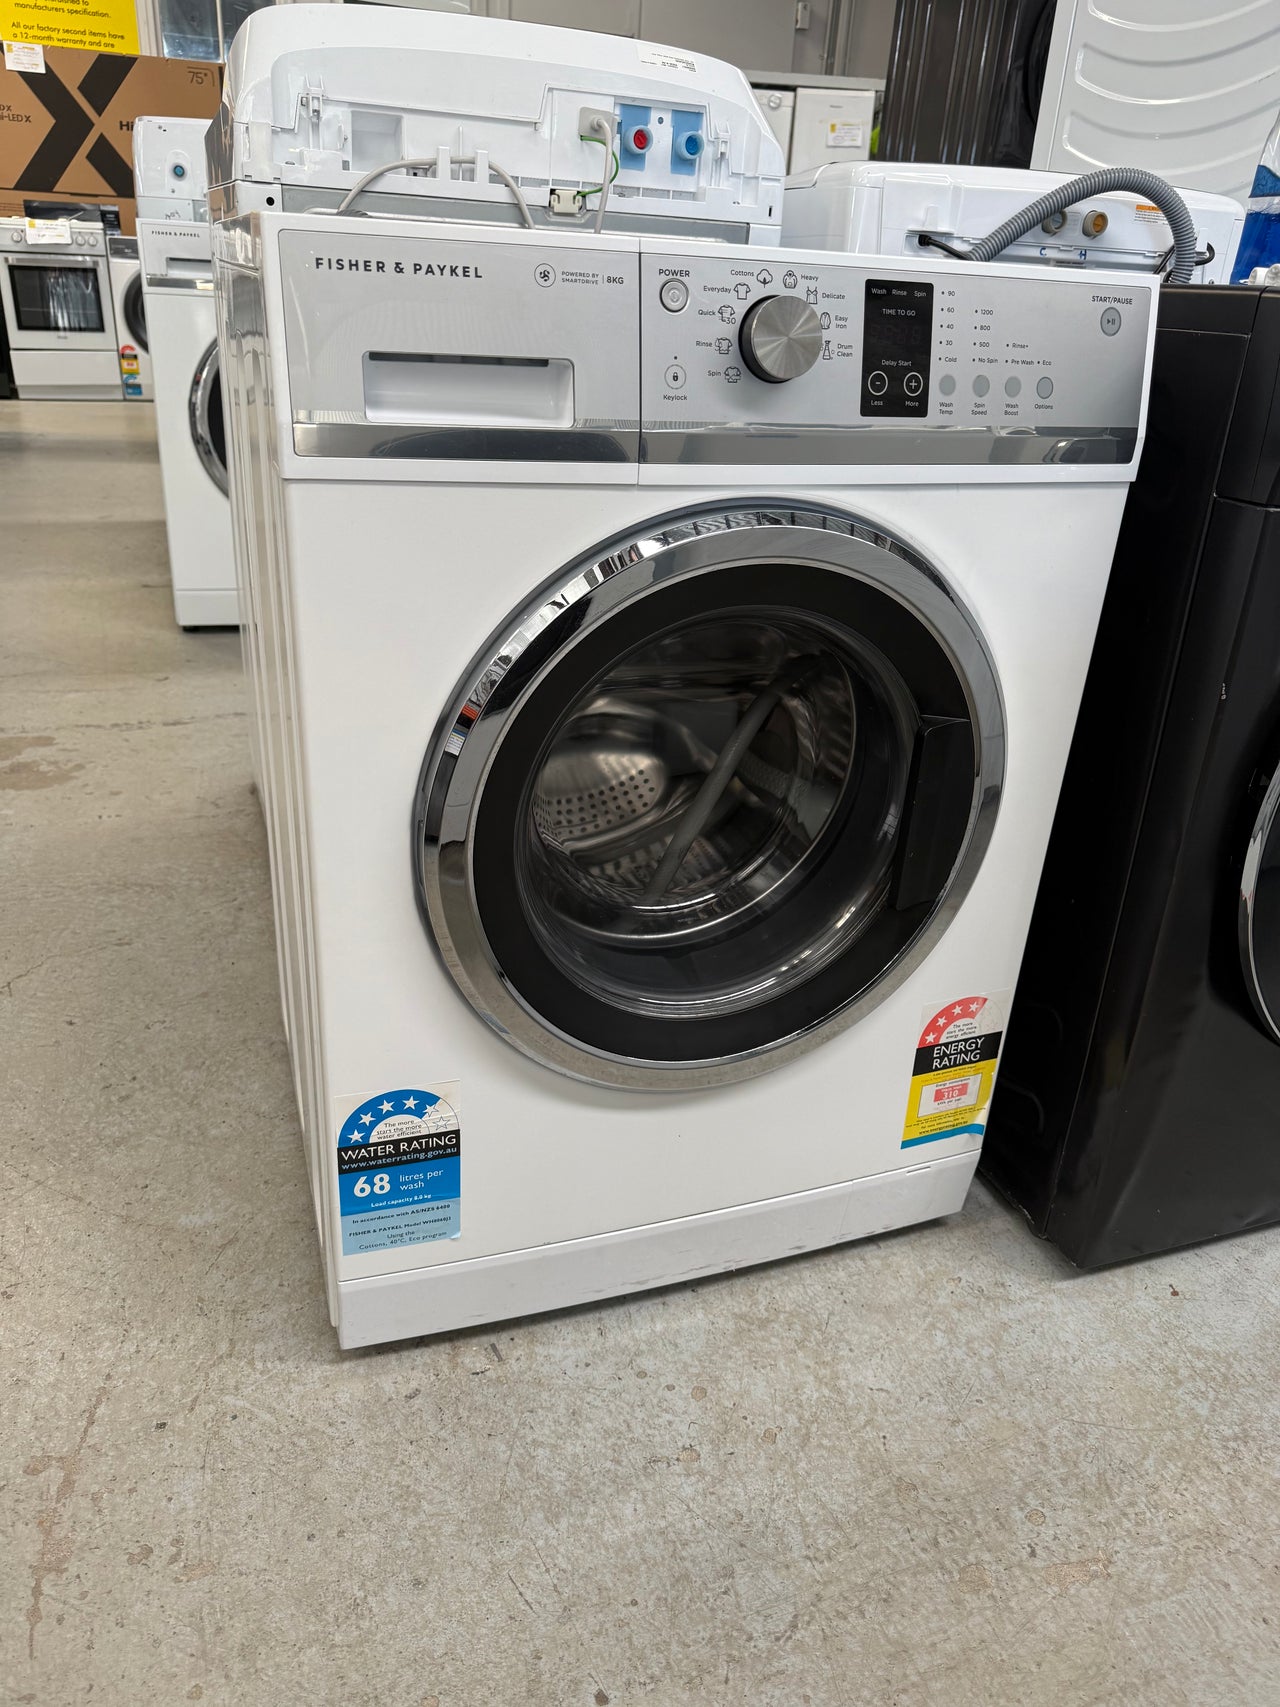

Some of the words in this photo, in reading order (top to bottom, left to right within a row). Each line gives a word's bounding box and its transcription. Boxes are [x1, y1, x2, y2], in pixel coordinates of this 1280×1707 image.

[14, 2, 65, 13] manufacturers
[37, 24, 60, 34] factory
[62, 28, 86, 36] second
[88, 30, 107, 38] items
[108, 32, 125, 40] have
[20, 32, 54, 42] 12-month
[56, 37, 87, 47] warranty
[1078, 250, 1087, 260] H
[315, 257, 386, 273] FISHER
[394, 262, 405, 274] &
[413, 263, 483, 279] PAYKEL
[658, 269, 690, 278] POWER
[801, 274, 819, 282] Heavy
[606, 276, 624, 284] 8KG
[704, 286, 732, 294] Everyday
[1092, 296, 1133, 305] START/PAUSE
[882, 308, 896, 316] TIME
[835, 315, 848, 323] Easy
[933, 1037, 984, 1057] ENERGY
[932, 1050, 980, 1069] RATING
[341, 1144, 396, 1160] WATER
[400, 1135, 456, 1152] RATING
[341, 1147, 457, 1170] www.waterrating.gov.au
[400, 1174, 424, 1182] litres
[428, 1170, 443, 1180] per
[354, 1173, 391, 1198] 68
[400, 1181, 424, 1191] wash
[387, 1197, 413, 1206] capacity
[360, 1214, 394, 1223] accordance
[359, 1242, 388, 1250] Cottons,
[422, 1231, 447, 1240] program
